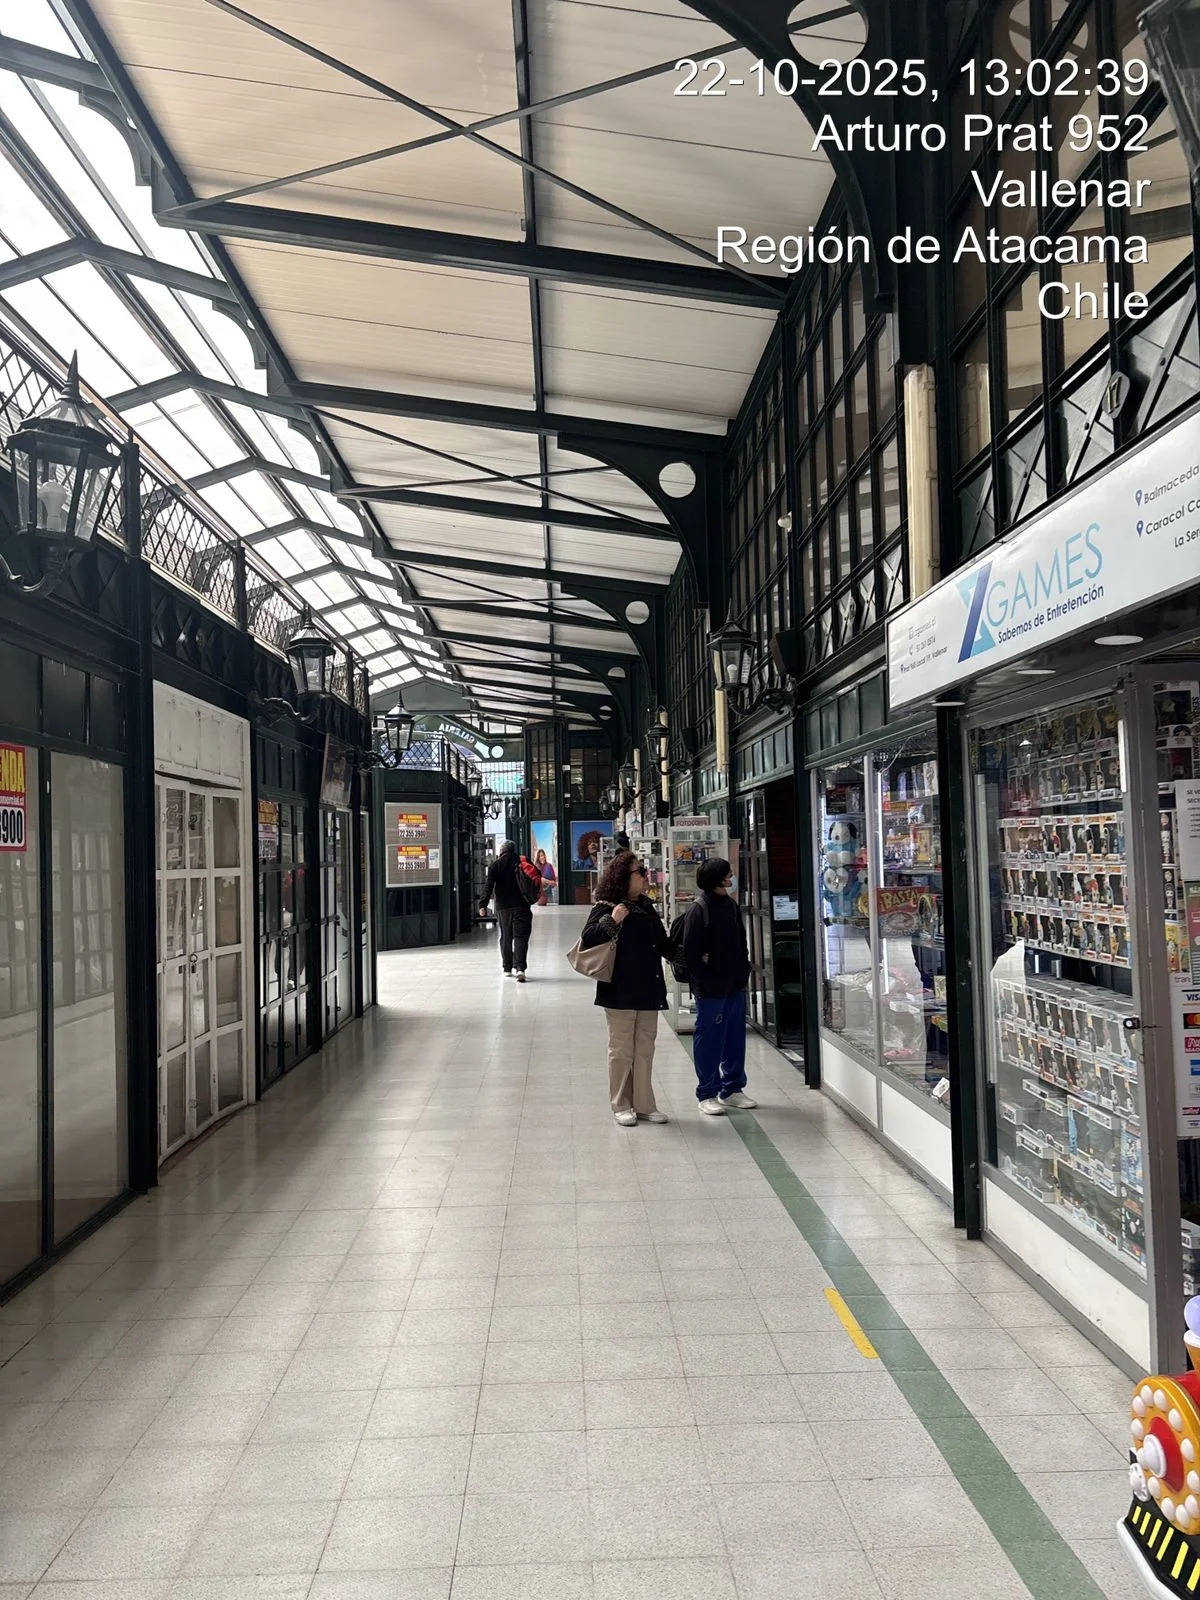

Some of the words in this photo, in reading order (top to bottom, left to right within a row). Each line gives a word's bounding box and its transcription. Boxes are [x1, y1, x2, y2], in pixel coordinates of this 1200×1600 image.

[1144, 465, 1199, 504] Balmaceda
[1145, 505, 1184, 534] Caracol
[1174, 536, 1184, 548] La
[1186, 528, 1200, 542] Ser
[998, 620, 1032, 644] Sabemos
[1033, 612, 1045, 627] de
[1046, 583, 1104, 622] Entretención
[0, 808, 23, 844] 900
